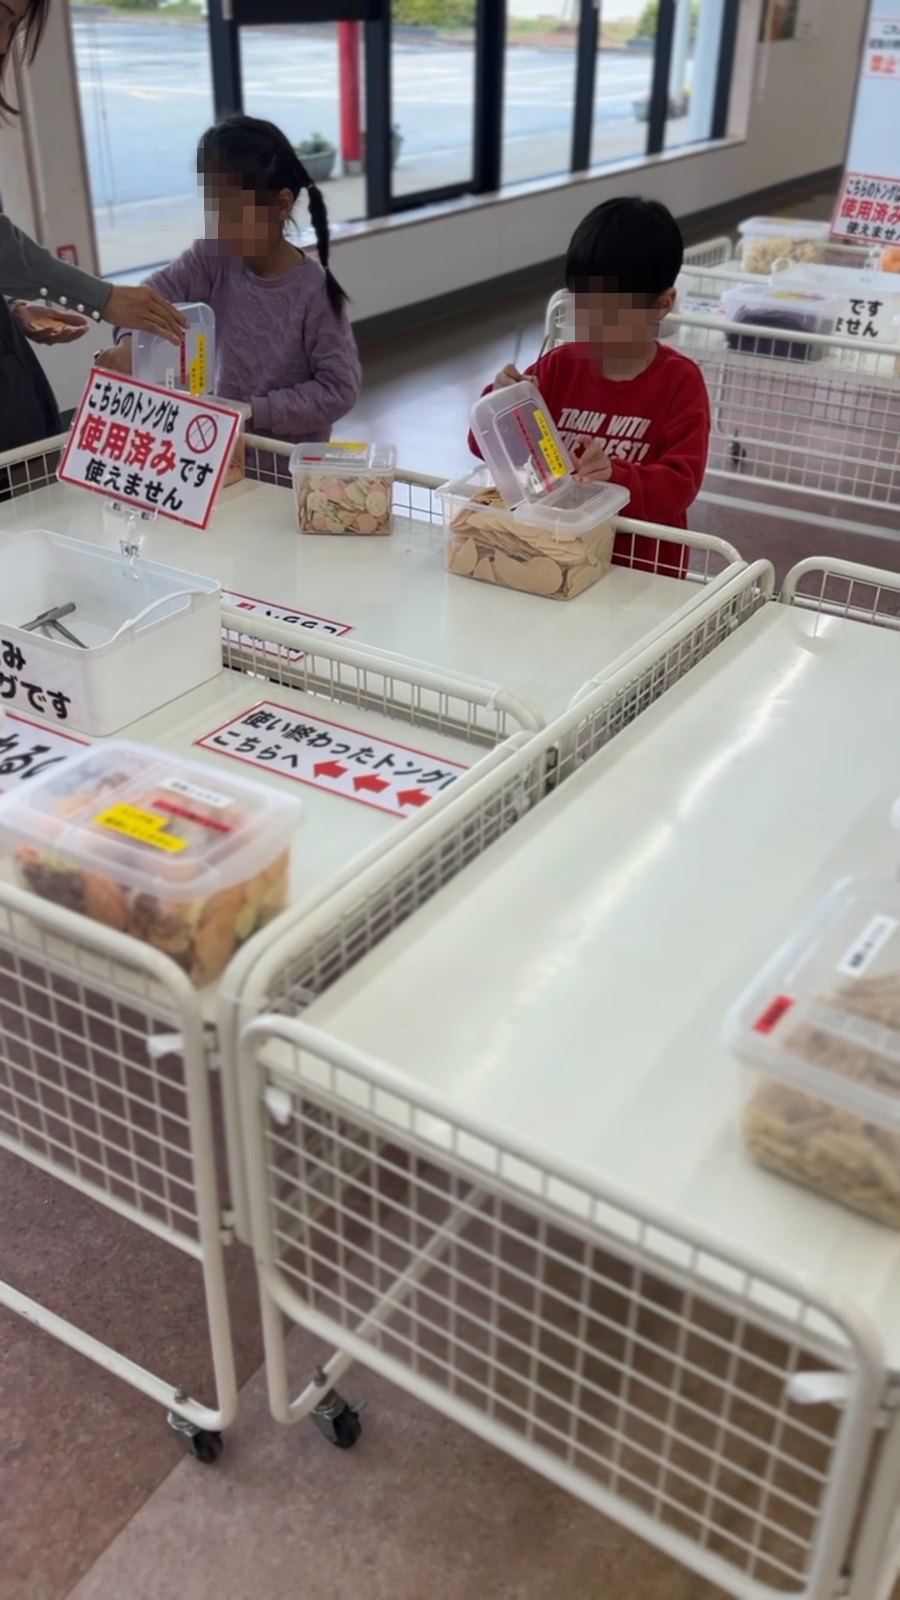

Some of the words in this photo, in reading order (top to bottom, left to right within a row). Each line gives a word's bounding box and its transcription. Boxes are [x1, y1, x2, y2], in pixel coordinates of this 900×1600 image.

[849, 298, 884, 317] です
[88, 382, 180, 434] こちらのトングは
[557, 407, 607, 434] TRAIN
[606, 415, 652, 440] WITH
[76, 412, 214, 488] 使用済みです
[84, 457, 183, 511] 使えません
[212, 730, 298, 769] こちらへ
